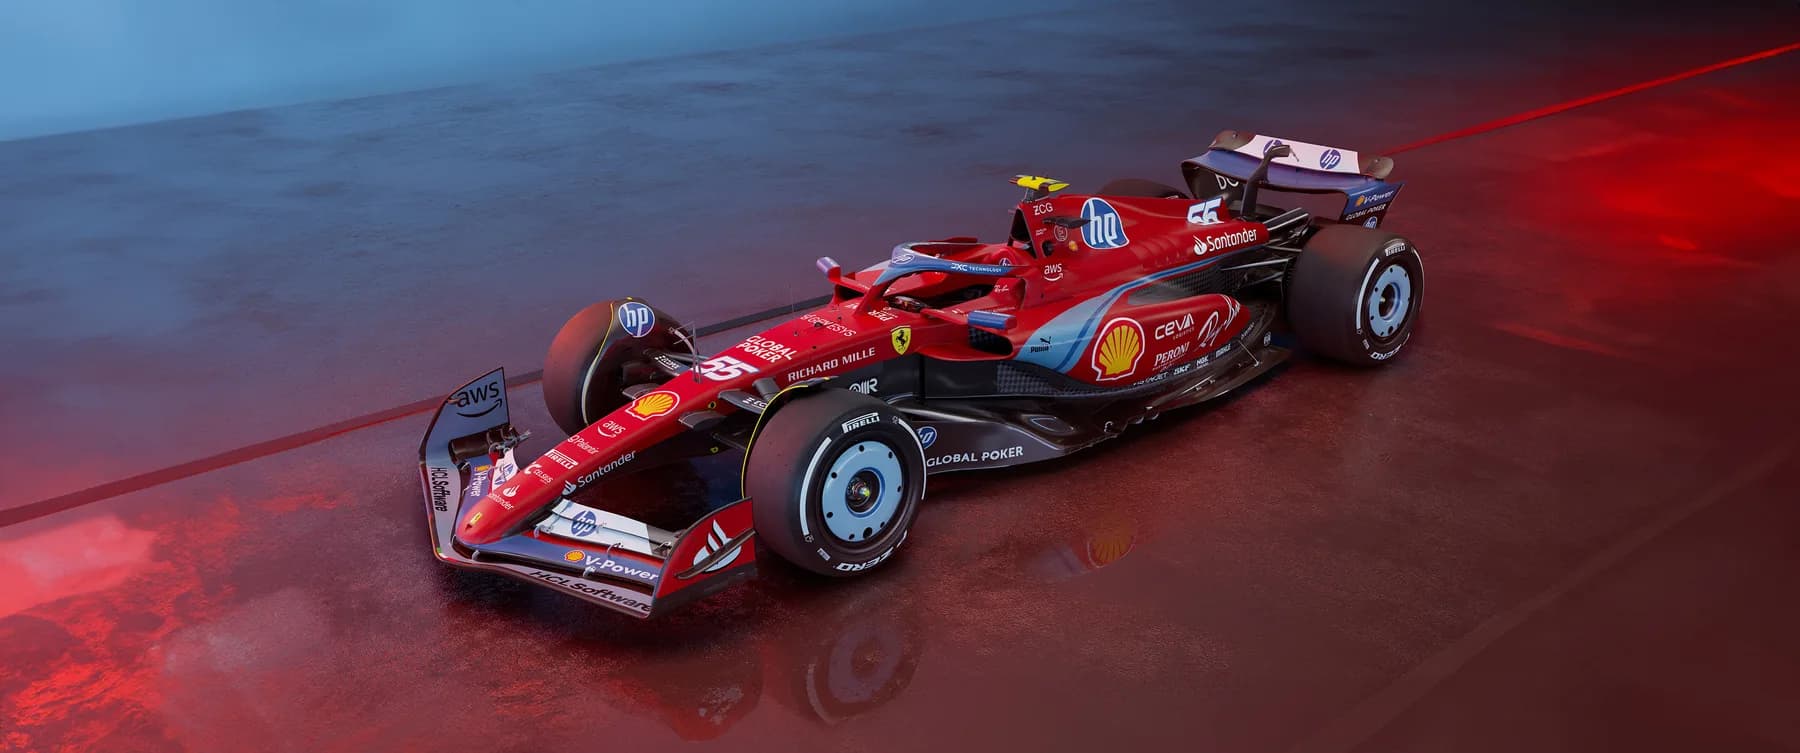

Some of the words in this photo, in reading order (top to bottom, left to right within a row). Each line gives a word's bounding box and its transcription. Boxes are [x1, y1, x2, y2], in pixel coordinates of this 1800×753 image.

[1320, 149, 1341, 170] hp
[1033, 203, 1054, 216] ZCG
[1187, 197, 1224, 226] 55
[1084, 198, 1126, 249] hp
[1207, 228, 1257, 252] Santander
[1044, 263, 1063, 275] aws
[622, 304, 650, 338] hp
[736, 341, 783, 363] POKER
[746, 335, 798, 361] GLOBAL
[694, 355, 760, 382] 55
[788, 358, 839, 383] RICHARD
[842, 347, 876, 365] MILLE
[457, 381, 500, 408] aws
[602, 420, 627, 434] aws
[841, 412, 880, 434] PIRELLI
[576, 436, 600, 455] Palantir
[926, 453, 978, 467] GLOBAL
[981, 445, 1024, 461] POKER
[544, 449, 578, 470] PIRELLI
[577, 450, 636, 488] Santander
[572, 510, 596, 536] hp
[585, 555, 660, 580] V-Power
[530, 570, 652, 612] HCLSoftware
